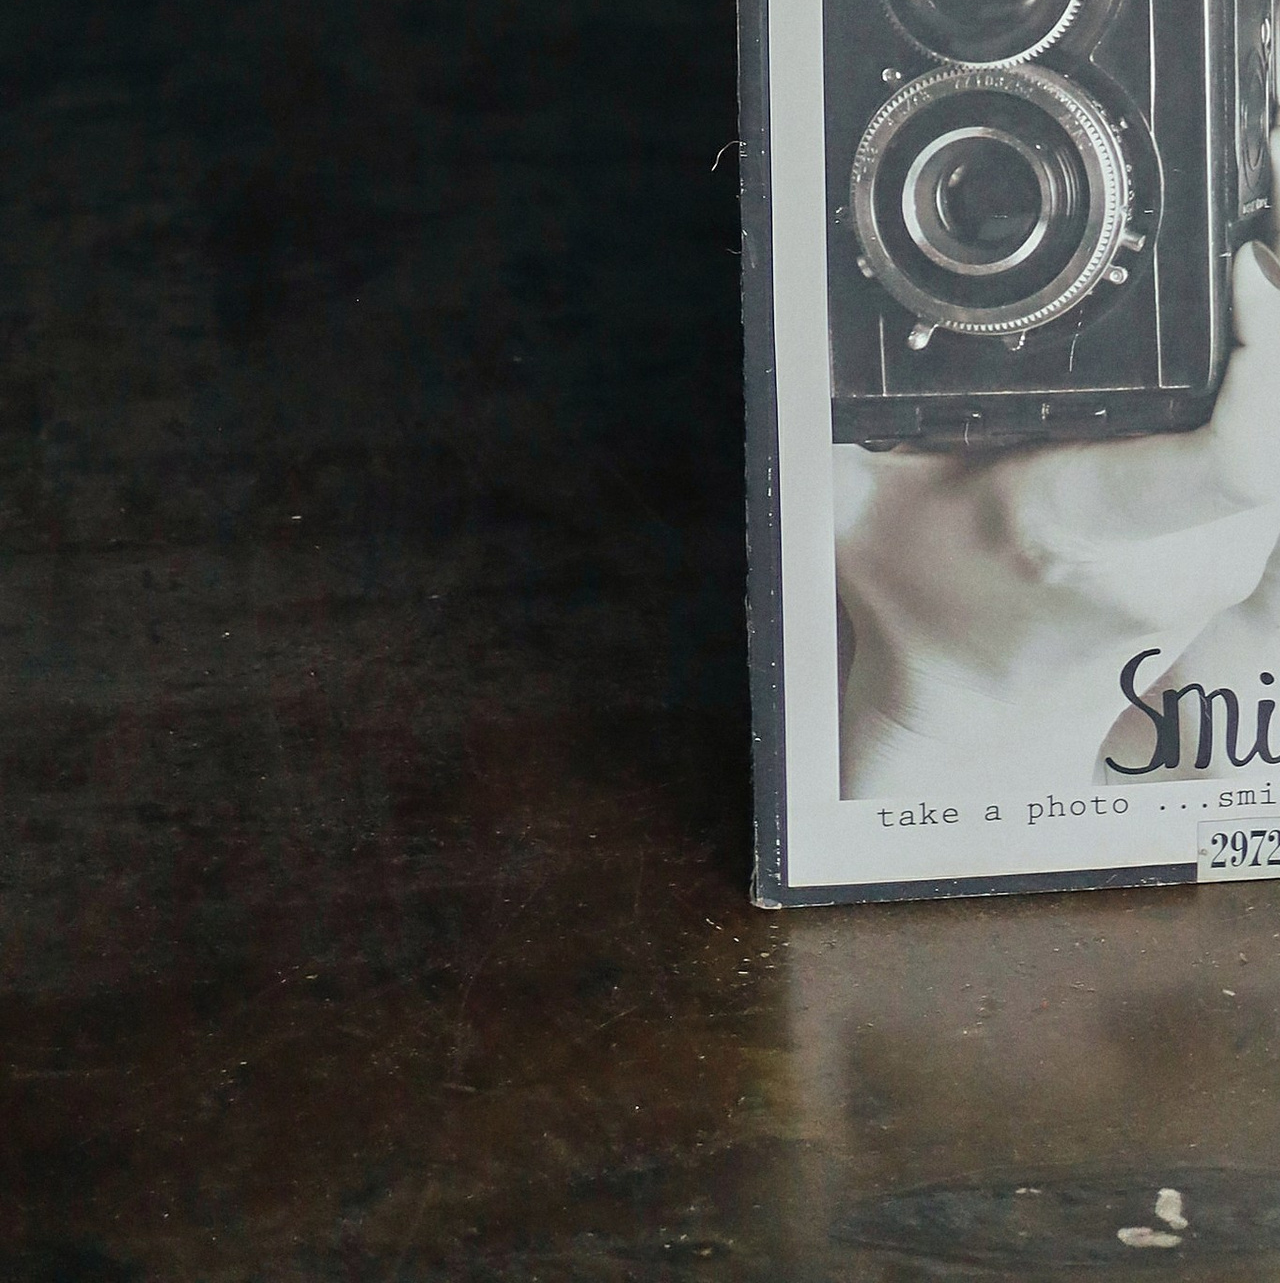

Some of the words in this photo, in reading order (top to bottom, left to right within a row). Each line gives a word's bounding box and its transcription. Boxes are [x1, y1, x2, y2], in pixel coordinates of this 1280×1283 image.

[877, 802, 960, 828] take
[984, 804, 1003, 822] a
[1027, 794, 1130, 825] photo
